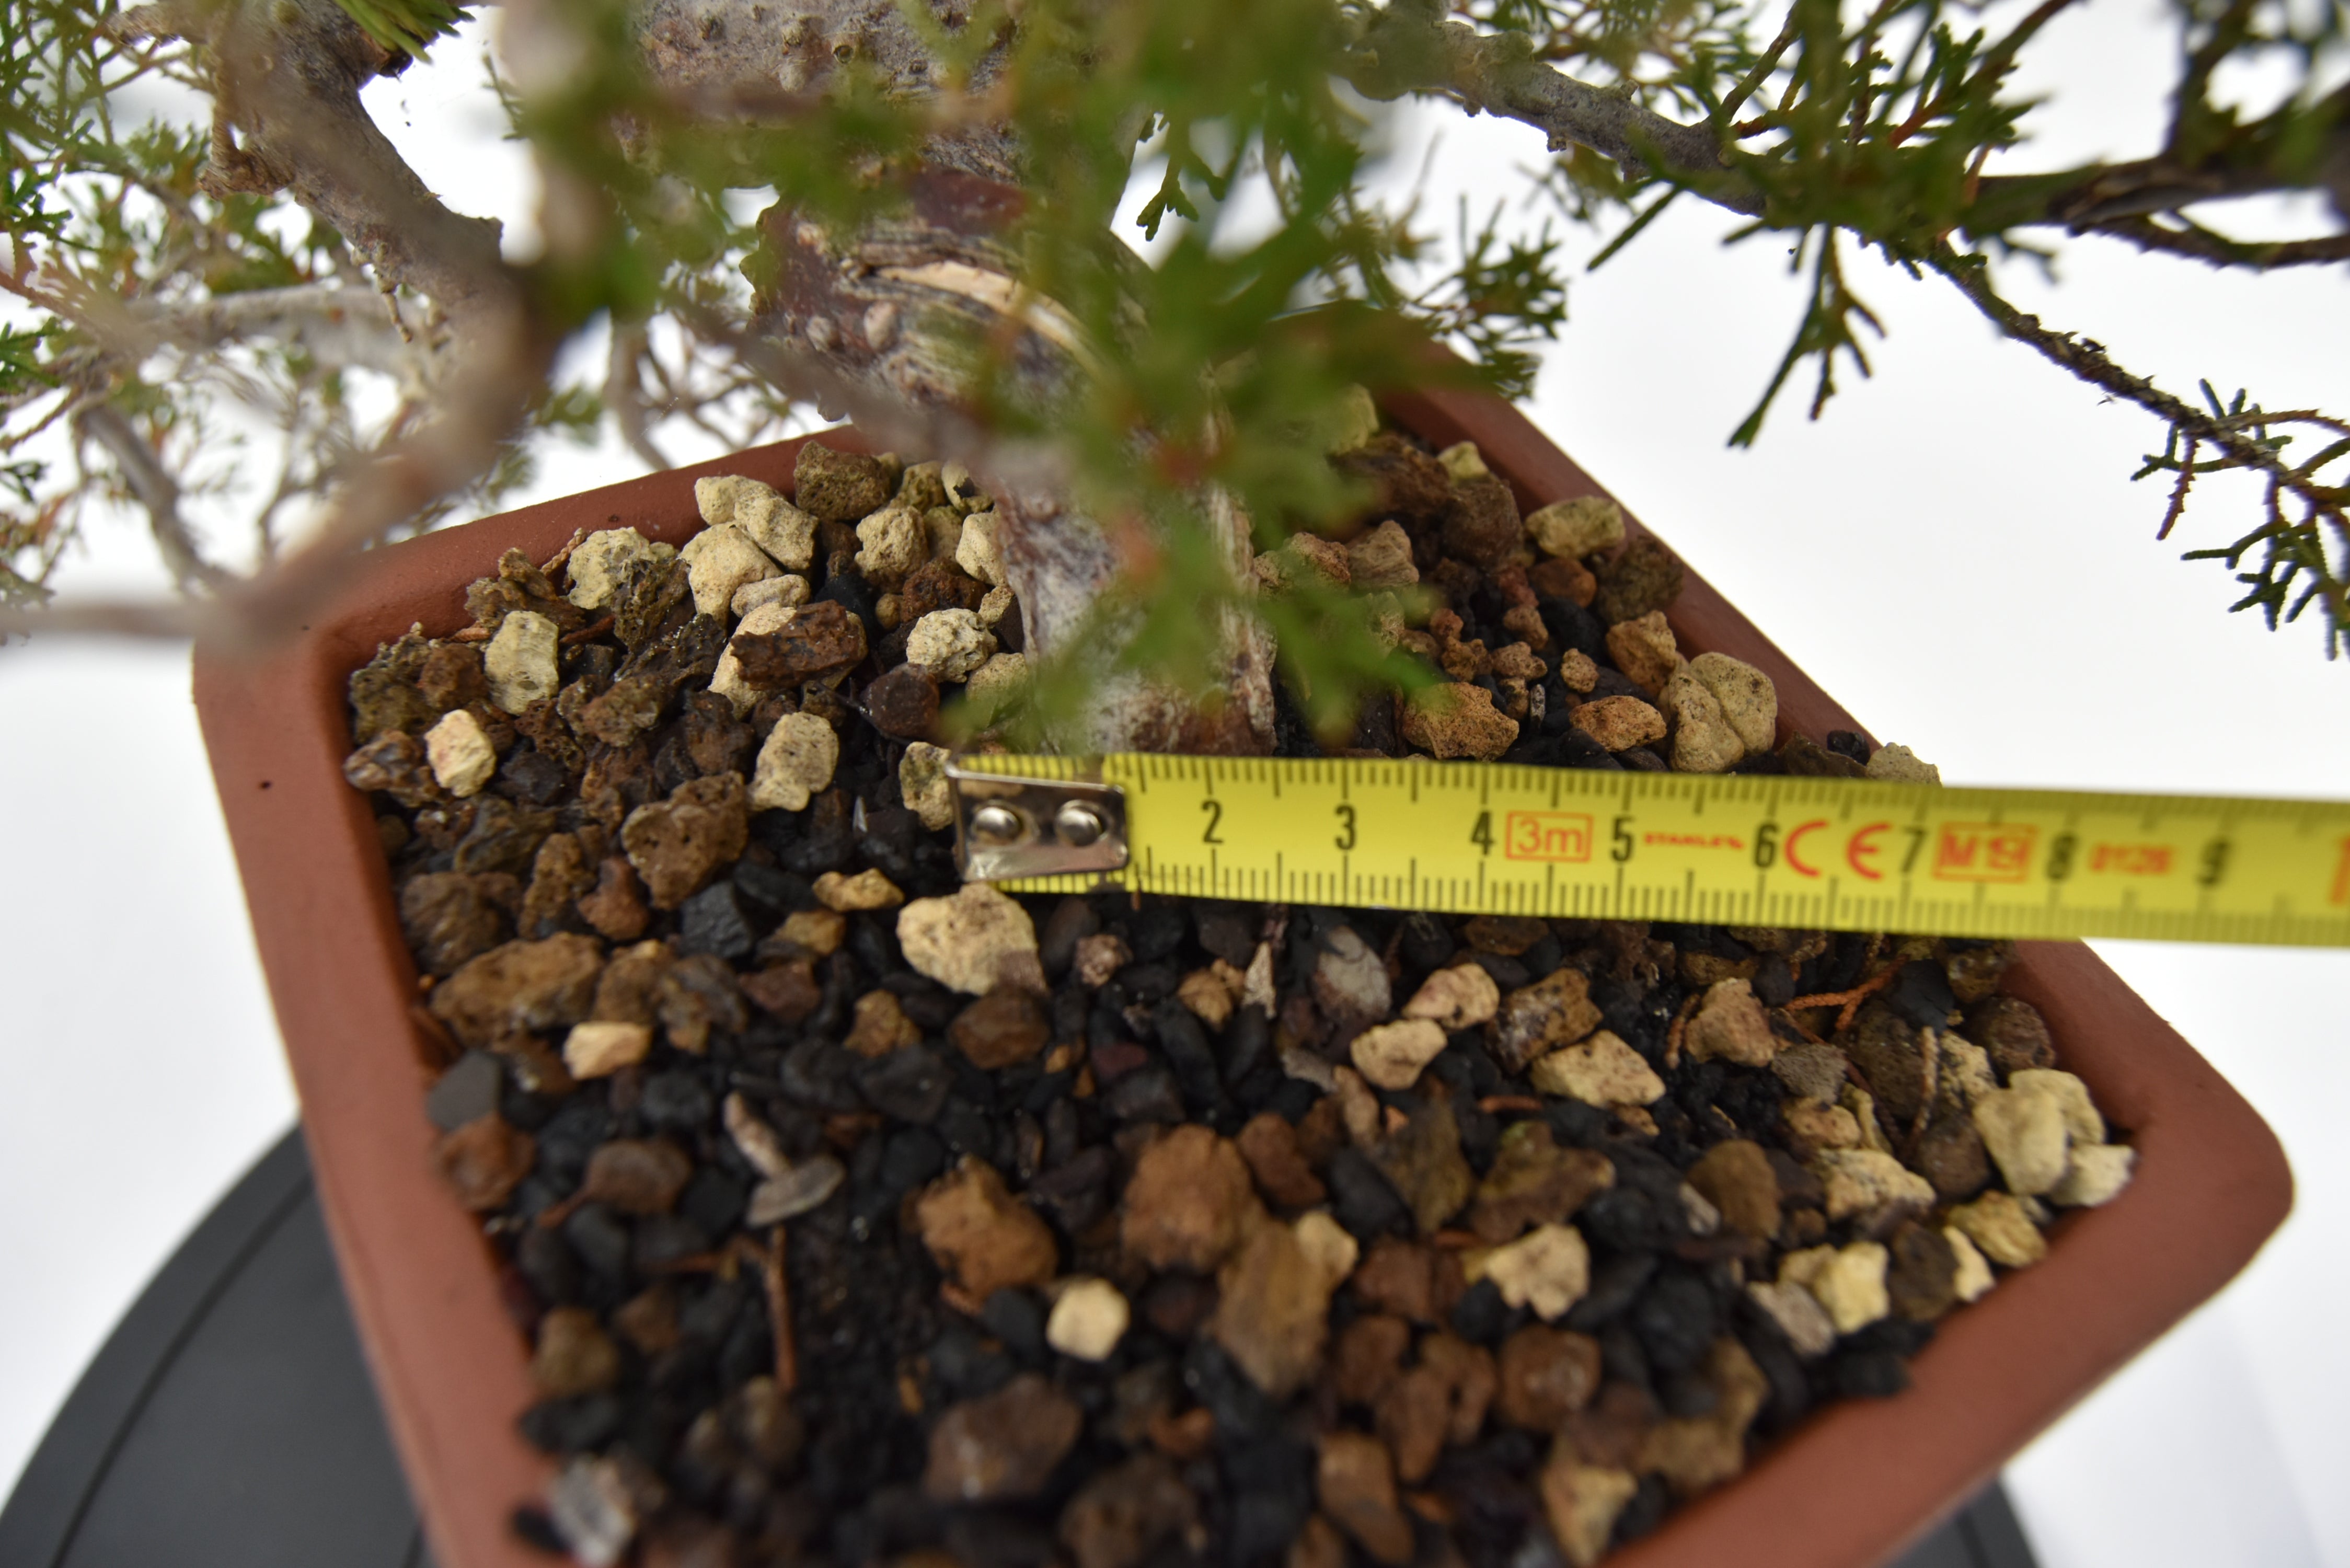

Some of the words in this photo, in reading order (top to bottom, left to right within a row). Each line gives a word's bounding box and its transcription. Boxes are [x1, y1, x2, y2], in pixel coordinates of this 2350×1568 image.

[1201, 801, 1224, 845] 2
[1335, 805, 1356, 851] 3
[1471, 811, 1494, 856] 4
[1517, 818, 1583, 855] 3m
[1610, 816, 1633, 863] 5
[1753, 823, 1779, 869] 6
[1901, 827, 1929, 873] 7
[2046, 833, 2078, 881] 8
[2197, 840, 2232, 887] 9
